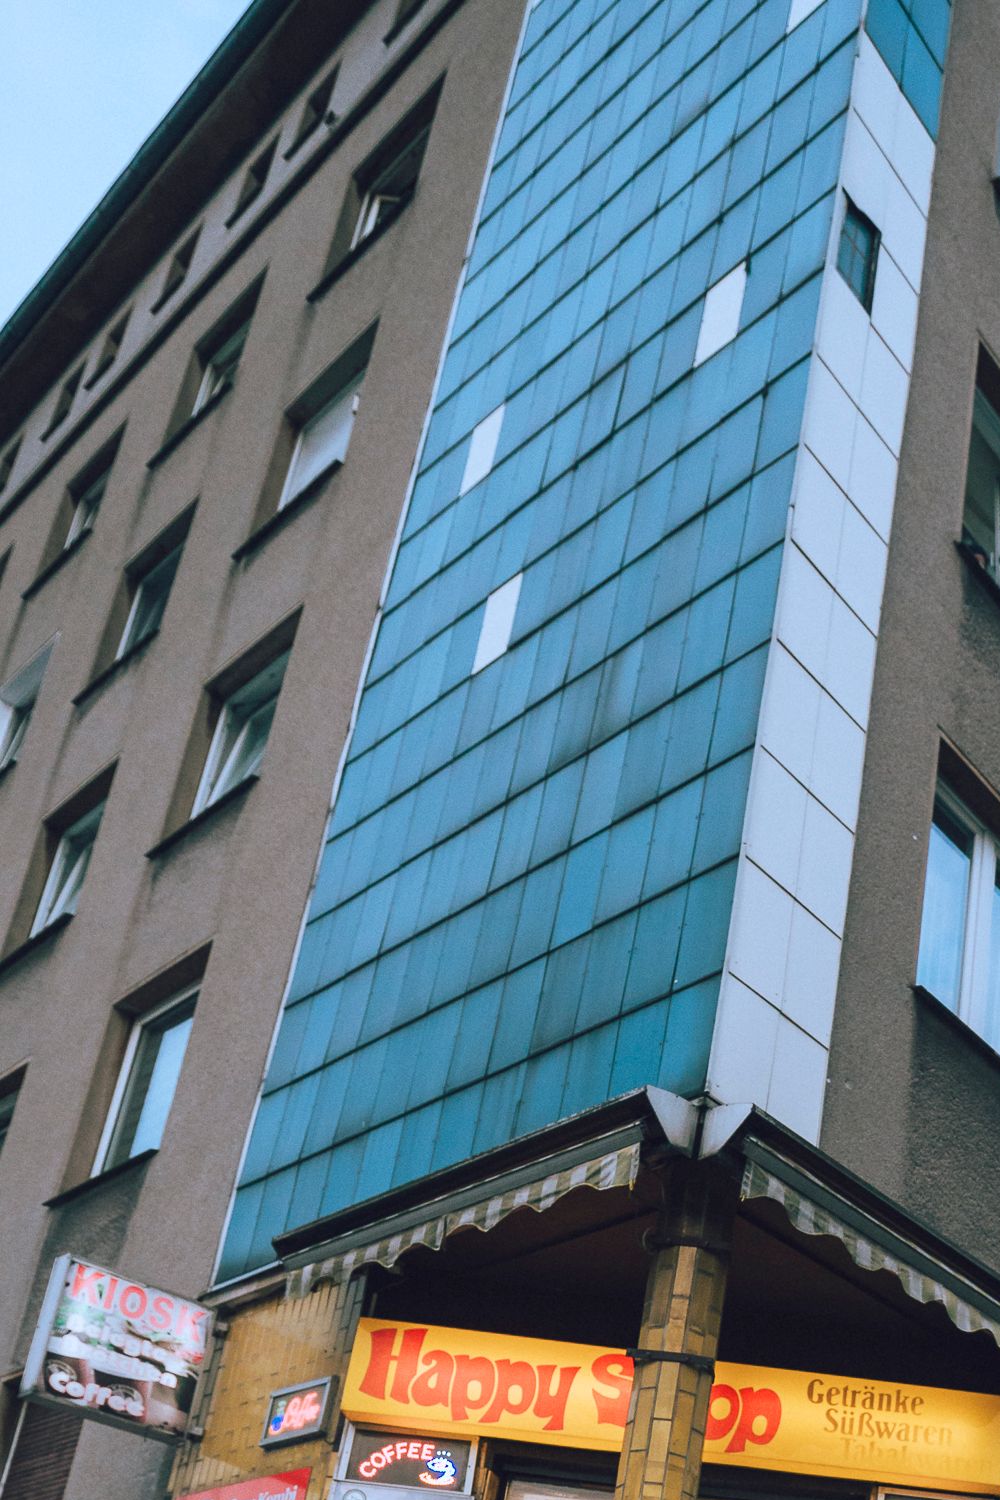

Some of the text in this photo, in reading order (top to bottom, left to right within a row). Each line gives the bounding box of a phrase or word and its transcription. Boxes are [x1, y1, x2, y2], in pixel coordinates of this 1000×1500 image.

[71, 1263, 209, 1343] KIOSK
[48, 1370, 145, 1417] Coffee
[359, 1326, 782, 1453] Happy Sop
[807, 1378, 926, 1416] Getränke
[823, 1407, 954, 1446] Süßwaren
[357, 1441, 436, 1478] COFFEE
